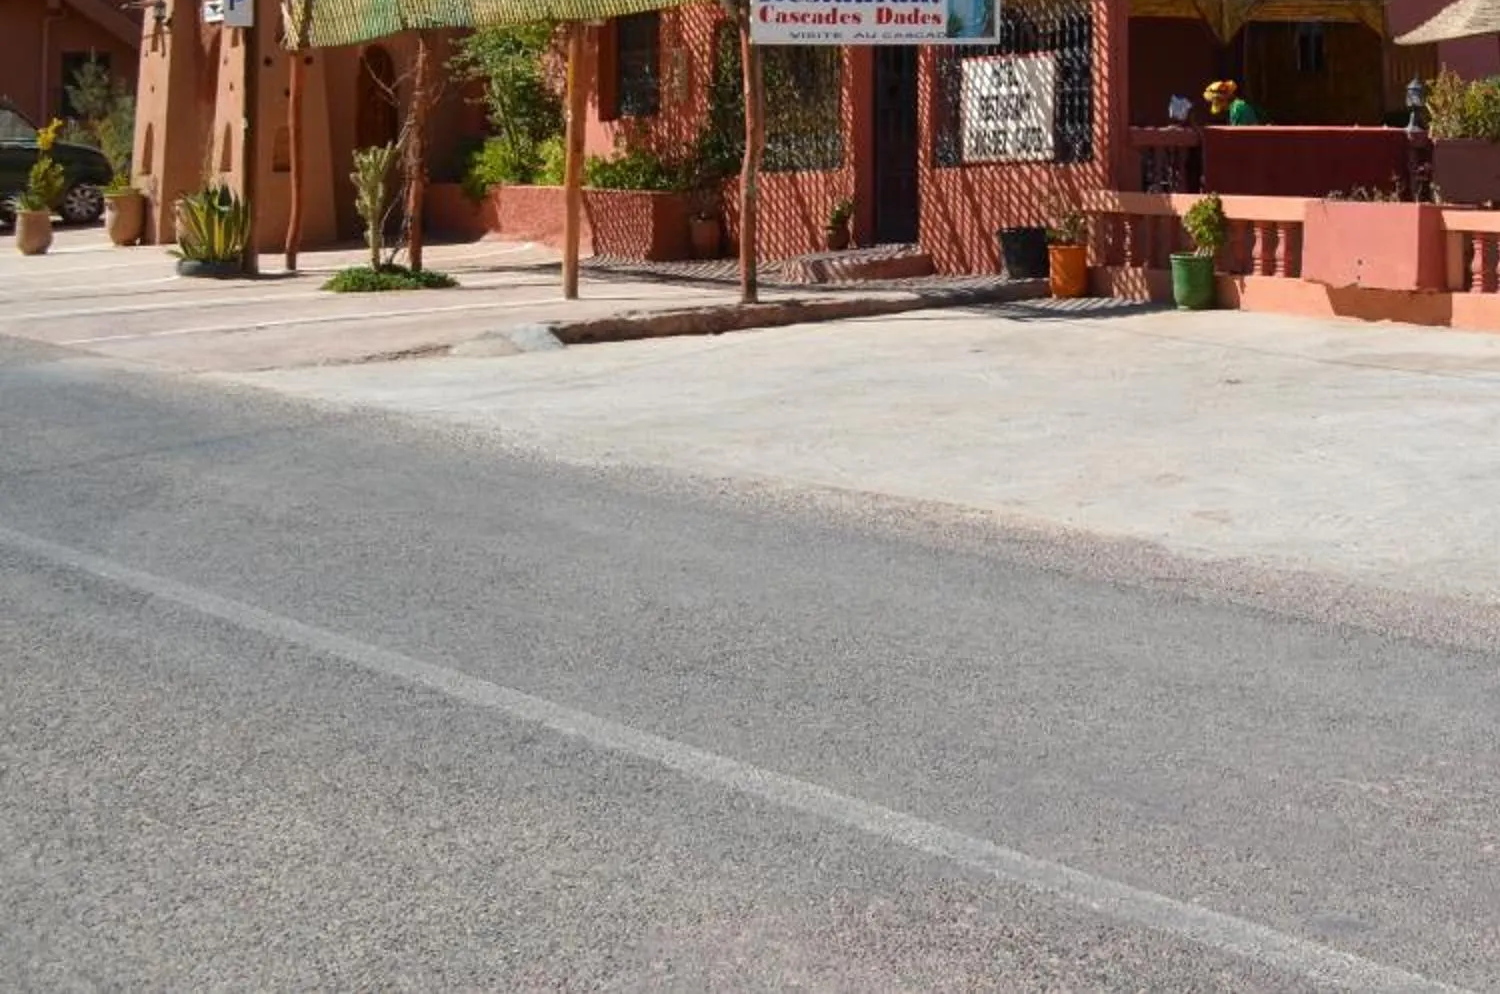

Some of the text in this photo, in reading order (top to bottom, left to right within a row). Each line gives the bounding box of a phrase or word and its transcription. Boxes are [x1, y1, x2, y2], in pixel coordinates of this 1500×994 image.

[759, 6, 942, 25] Cascades Dades
[789, 31, 843, 39] VISITE
